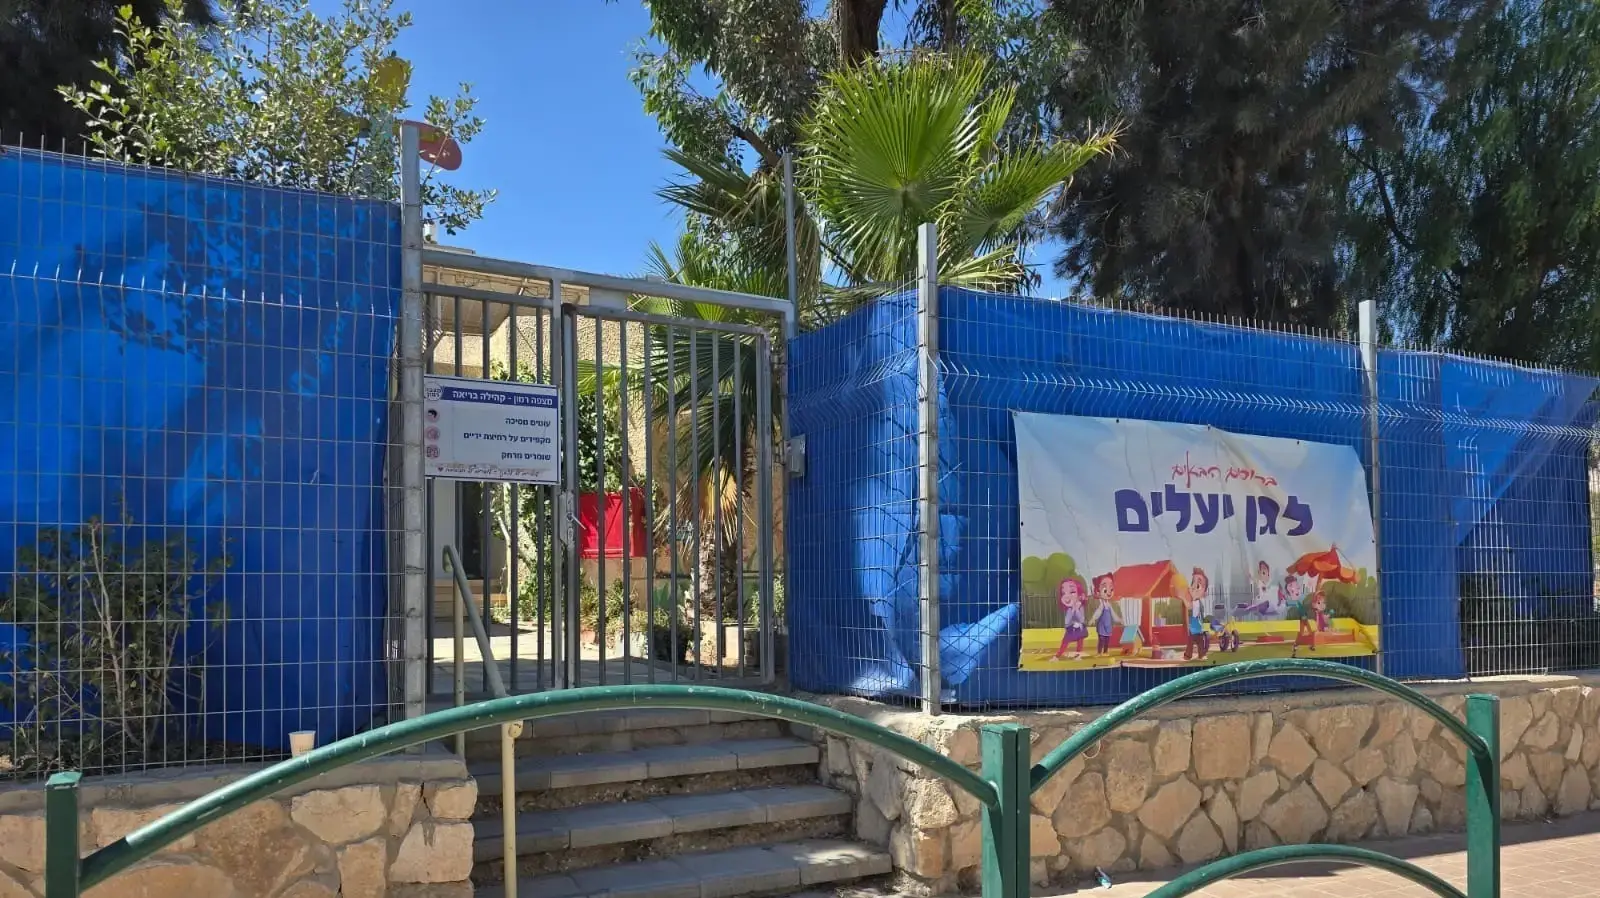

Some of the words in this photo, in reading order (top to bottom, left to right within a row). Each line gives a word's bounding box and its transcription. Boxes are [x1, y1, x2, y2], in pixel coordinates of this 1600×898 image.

[452, 390, 478, 399] בריאה
[480, 392, 506, 404] קהילה
[513, 396, 529, 405] רמון
[531, 397, 552, 406] מצפה
[505, 418, 528, 426] מסיכה
[530, 419, 551, 427] עוטים
[483, 433, 507, 441] רחיצת
[508, 434, 519, 442] על
[520, 436, 551, 445] מקפידים
[501, 451, 523, 460] מרחק
[524, 453, 551, 461] שומרים
[1171, 450, 1221, 489] הבאים
[1225, 466, 1278, 487] ברוכים
[1114, 483, 1235, 535] יעלים
[1245, 495, 1314, 542] לגן
